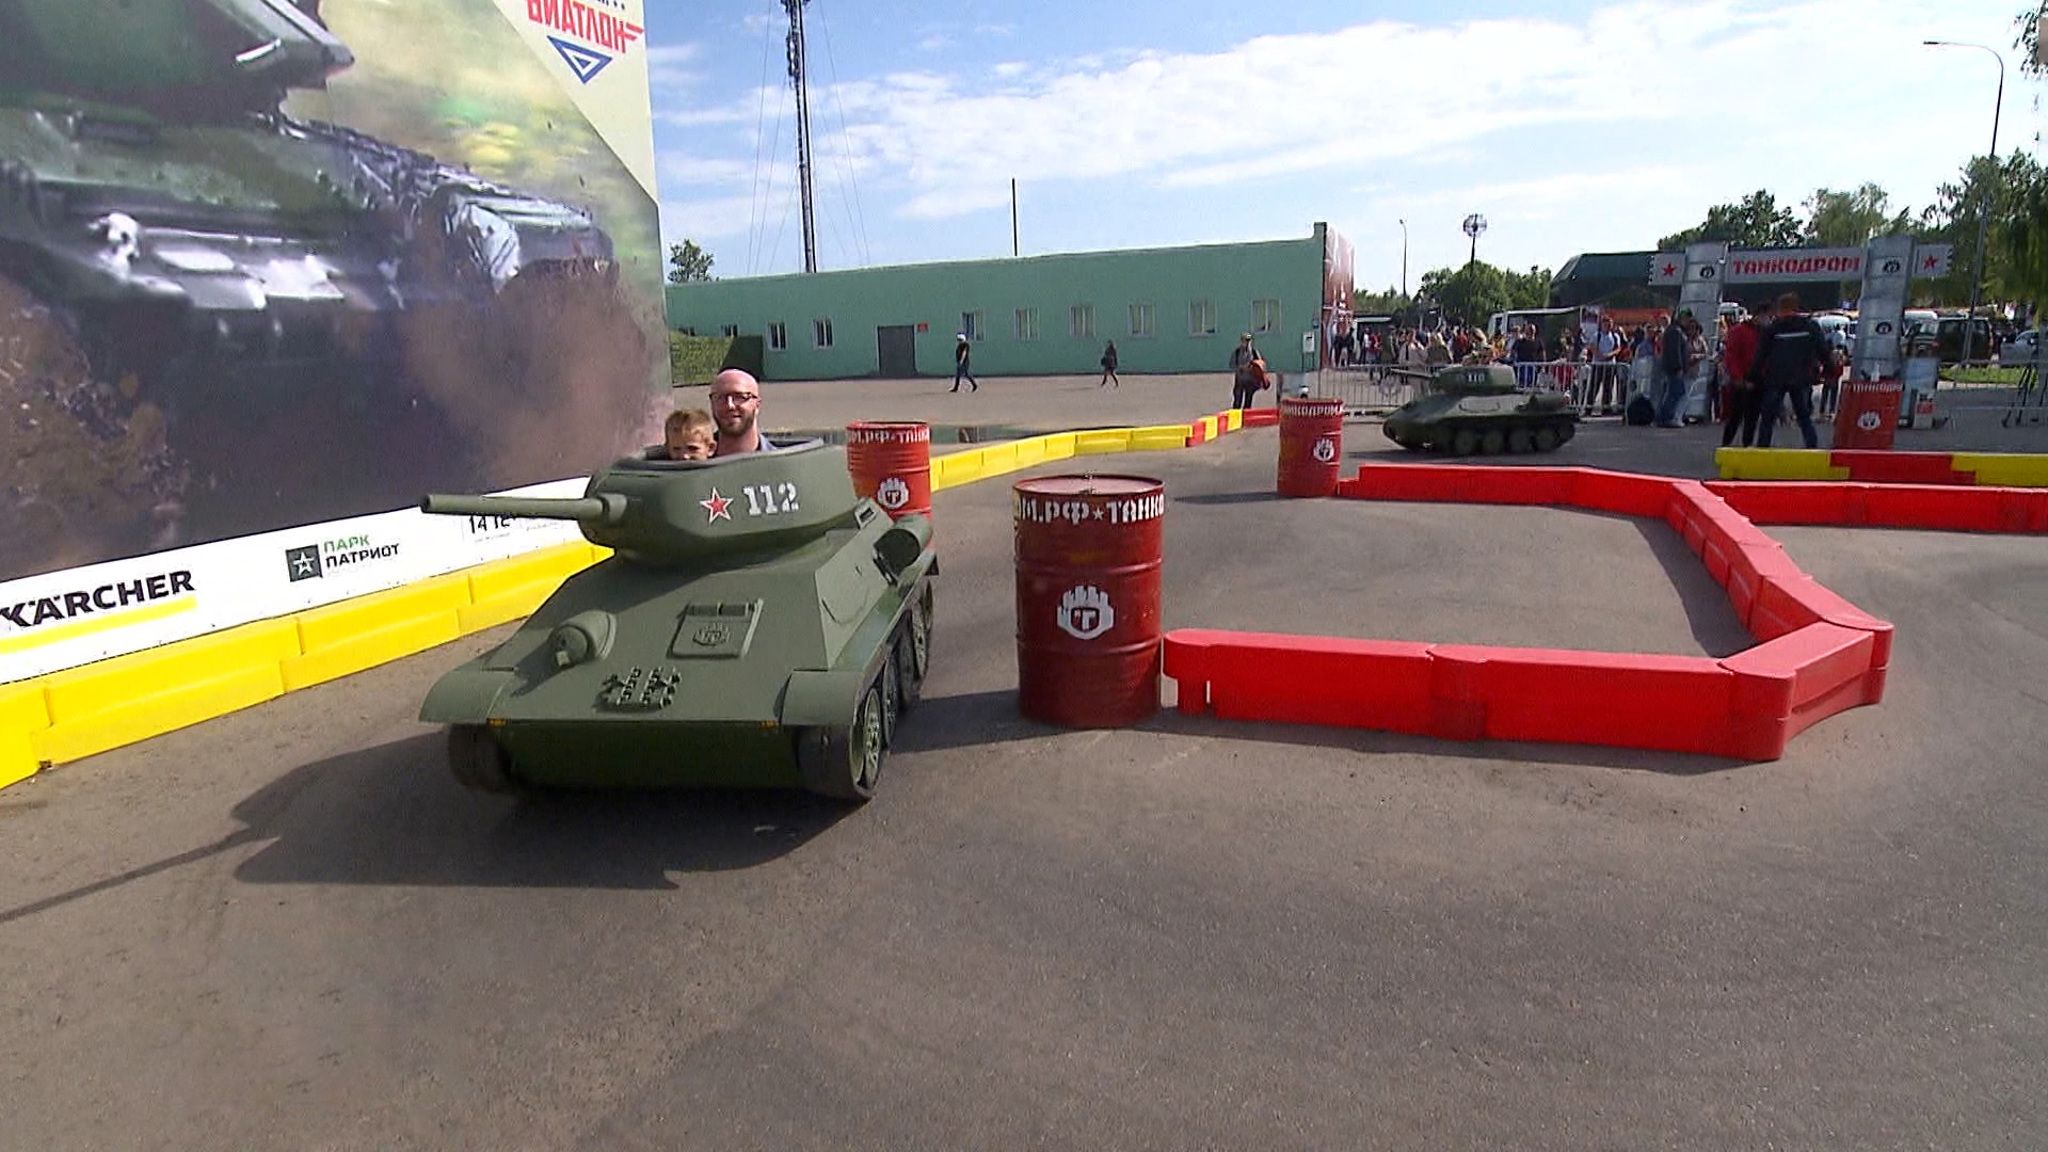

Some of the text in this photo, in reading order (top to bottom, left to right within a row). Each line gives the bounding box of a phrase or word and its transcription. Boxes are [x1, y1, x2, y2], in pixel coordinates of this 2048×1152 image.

[1733, 256, 1861, 275] ТАНКОДРОМ
[743, 482, 800, 516] 112
[324, 534, 370, 553] ПАРК
[325, 543, 400, 568] ПАТРИОТ
[0, 570, 195, 627] KÄRCHER
